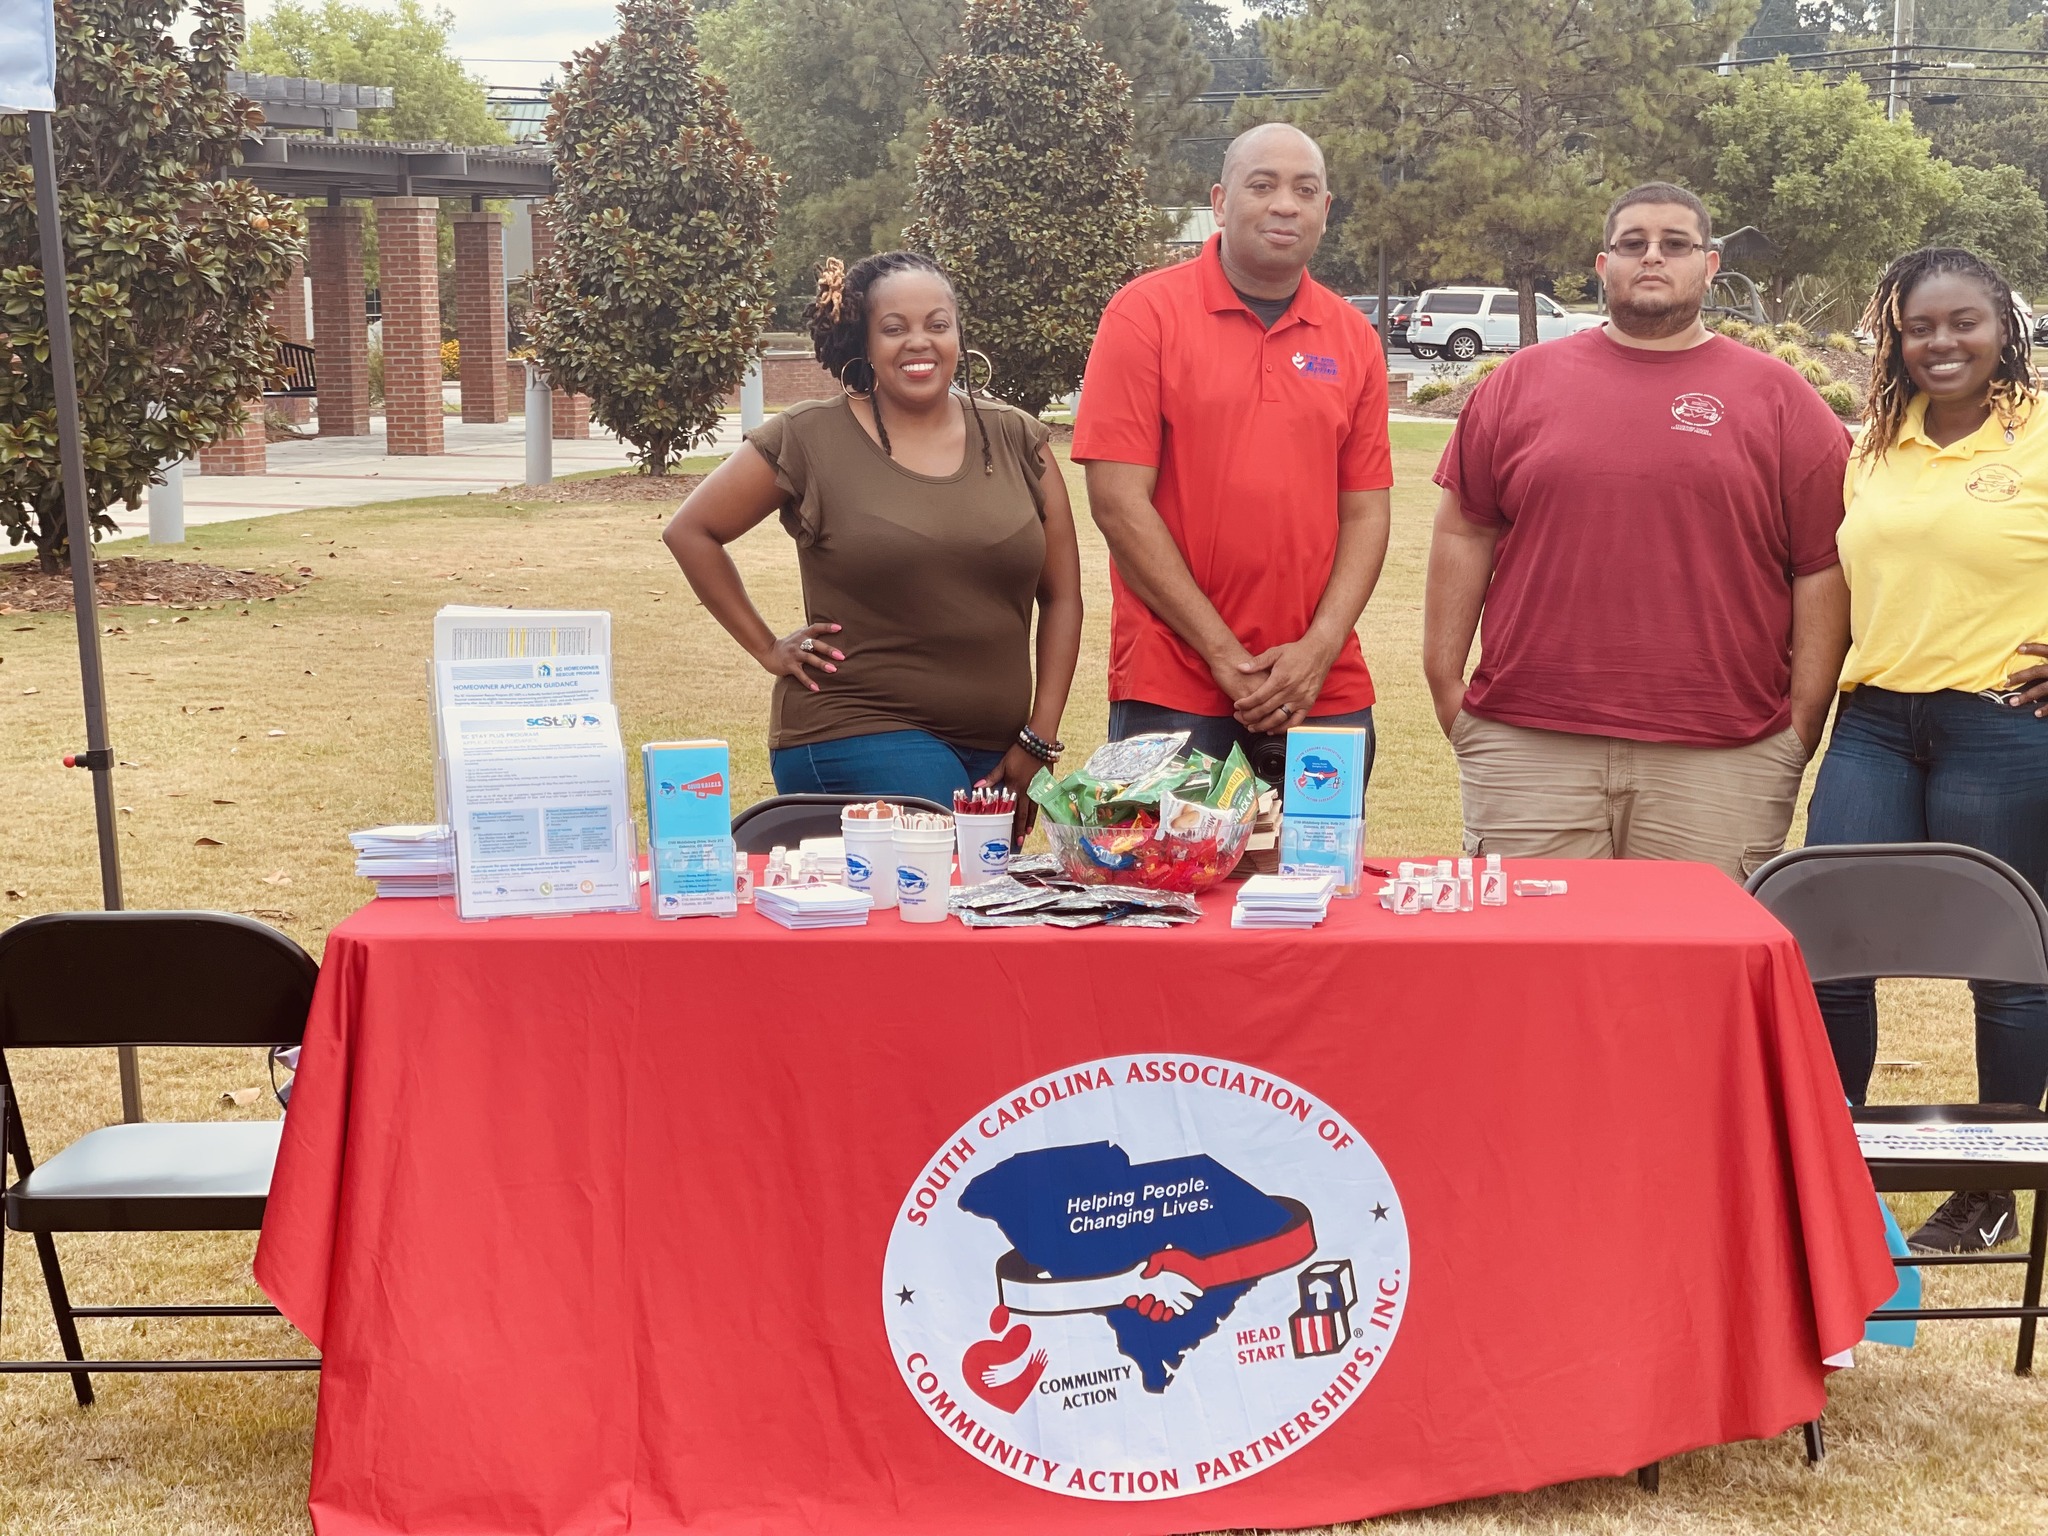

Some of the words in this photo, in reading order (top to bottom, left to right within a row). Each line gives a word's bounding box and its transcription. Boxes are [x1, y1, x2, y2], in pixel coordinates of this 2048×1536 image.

[544, 680, 578, 688] GUIDANCE
[906, 1136, 977, 1227] SOUTH
[977, 1066, 1115, 1139] CAROLINA
[1125, 1060, 1313, 1123] ASSOCIATION
[1317, 1118, 1354, 1152] OF
[1066, 1191, 1136, 1216] Helping
[1143, 1177, 1210, 1206] People.
[1069, 1206, 1156, 1235] Changing
[1162, 1195, 1214, 1219] Lives.
[1236, 1325, 1281, 1345] HEAD
[1237, 1343, 1287, 1365] START
[906, 1351, 1060, 1484] COMMUNITY
[1066, 1468, 1180, 1494] ACTION
[1196, 1343, 1384, 1484] PARTNERSHIPS,
[1369, 1267, 1402, 1332] INC.
[1039, 1364, 1132, 1395] COMMUNITY
[1062, 1386, 1118, 1411] ACTION
